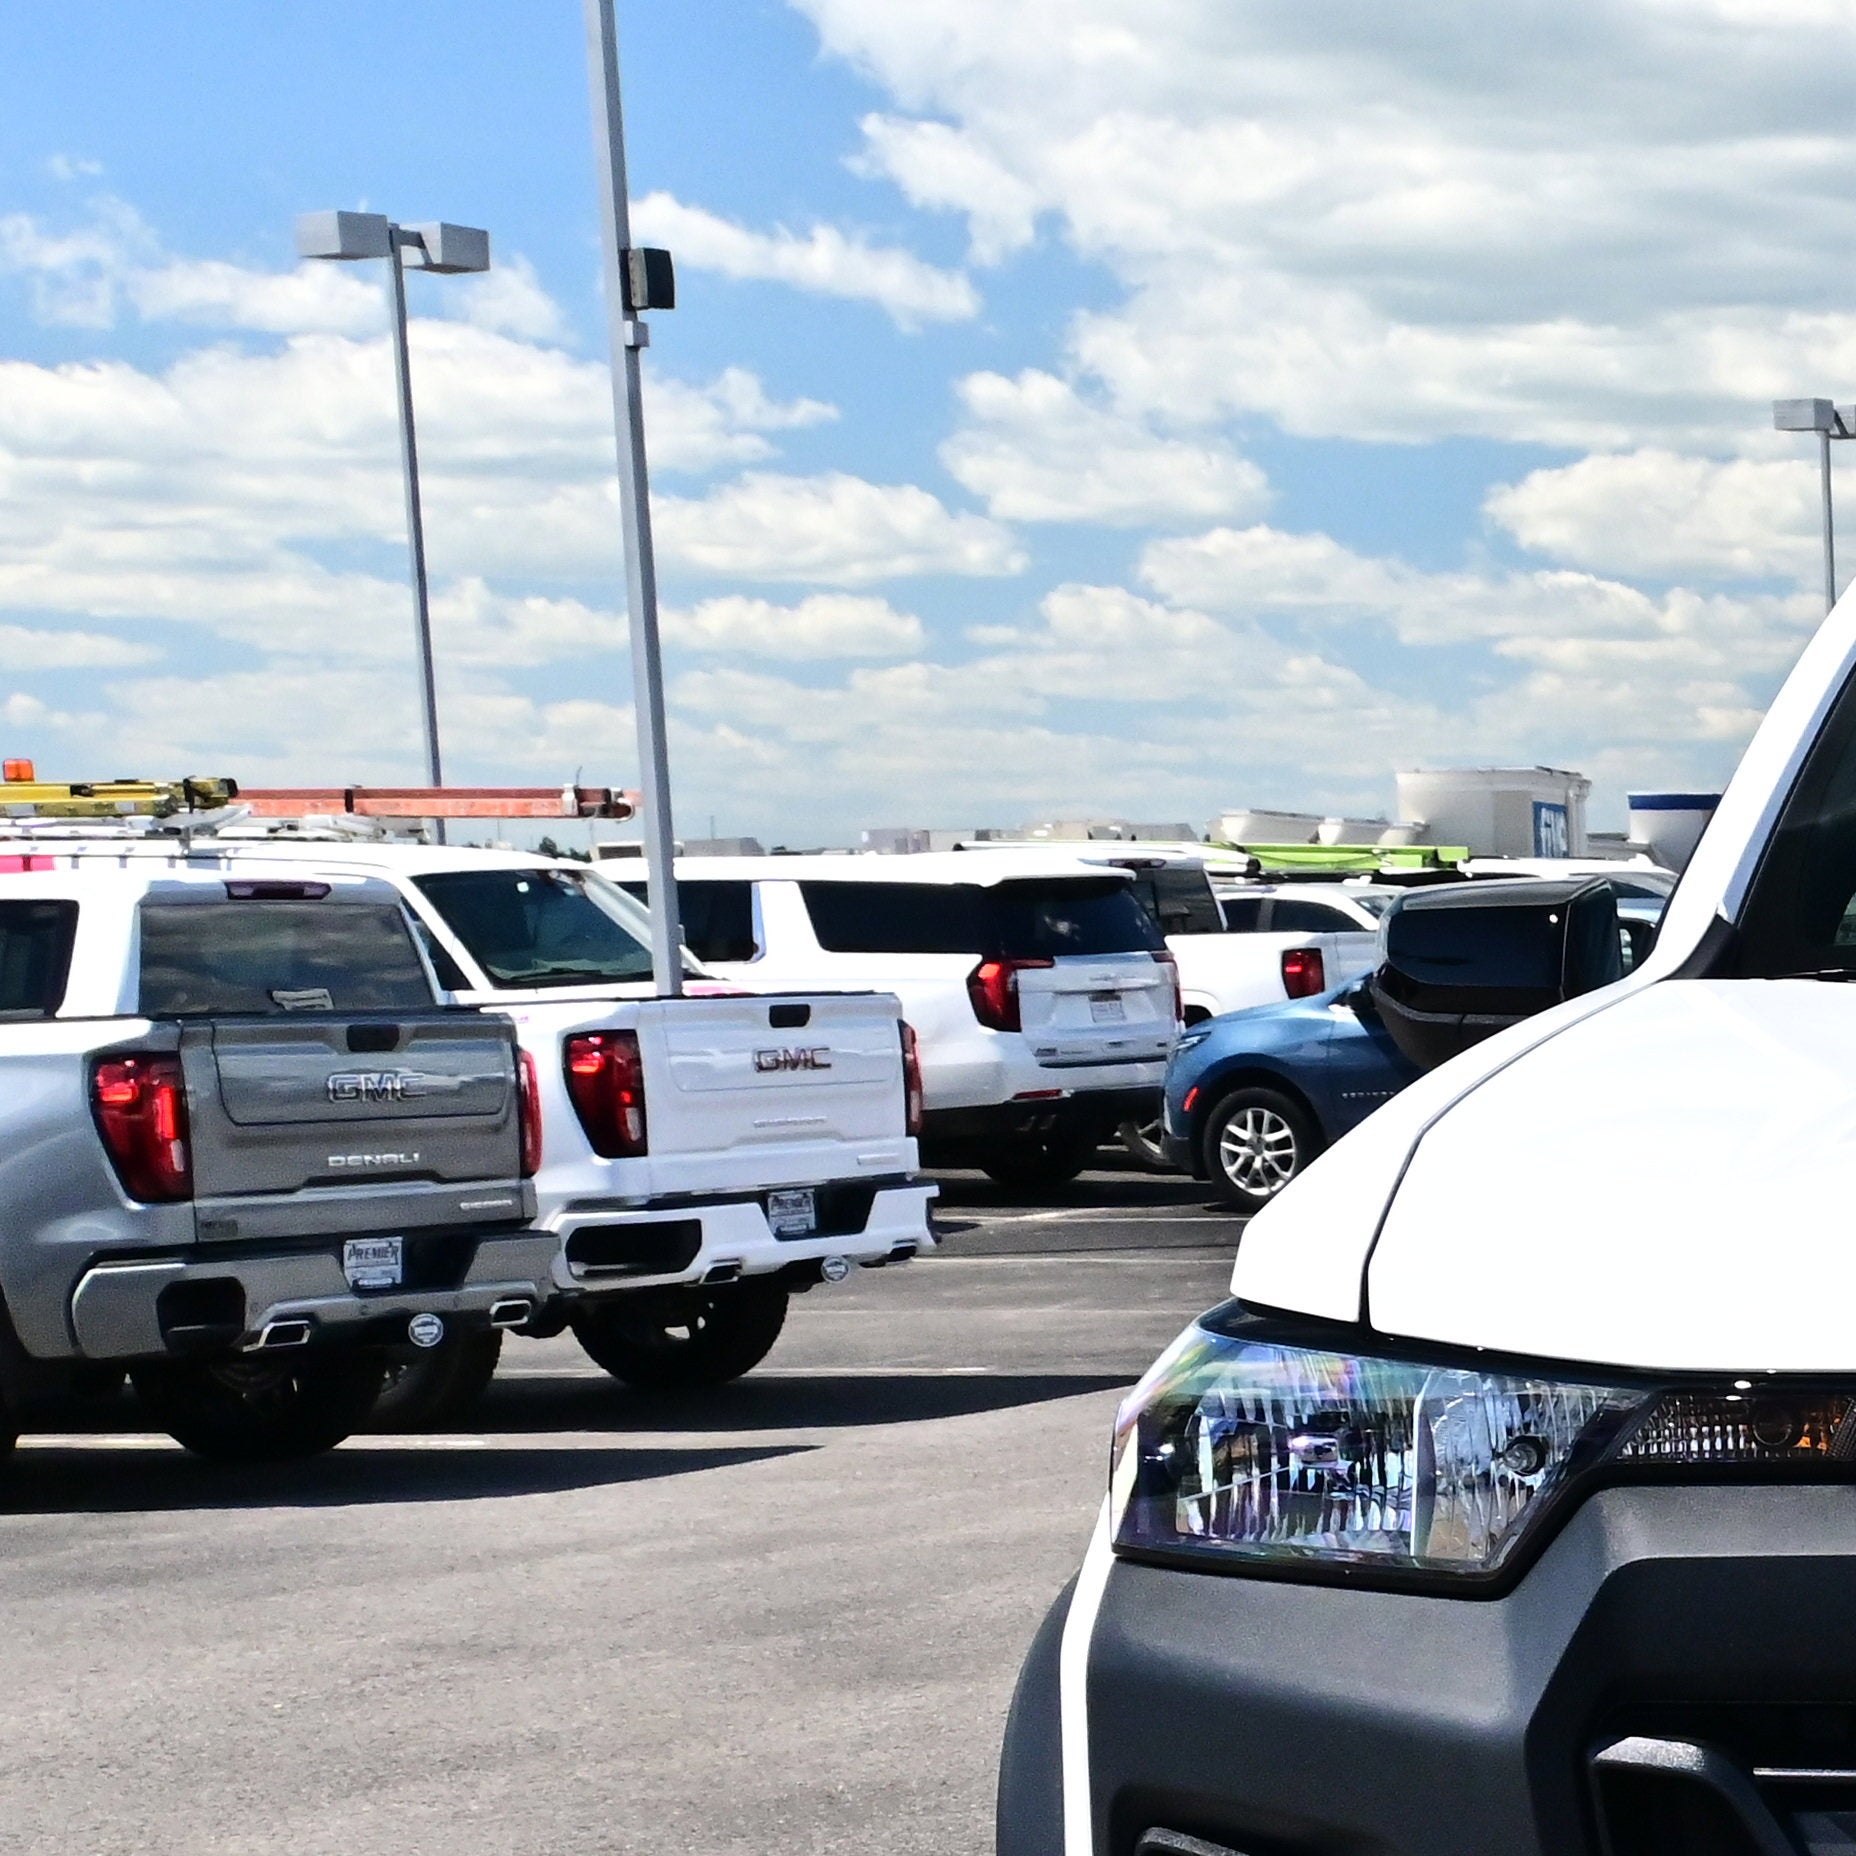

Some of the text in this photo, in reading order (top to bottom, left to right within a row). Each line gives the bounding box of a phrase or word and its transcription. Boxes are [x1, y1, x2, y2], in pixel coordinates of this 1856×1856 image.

[754, 1047, 832, 1073] GMC
[328, 1070, 426, 1103] GMC
[328, 1152, 420, 1168] DENALI
[347, 1241, 399, 1265] PREMIER
